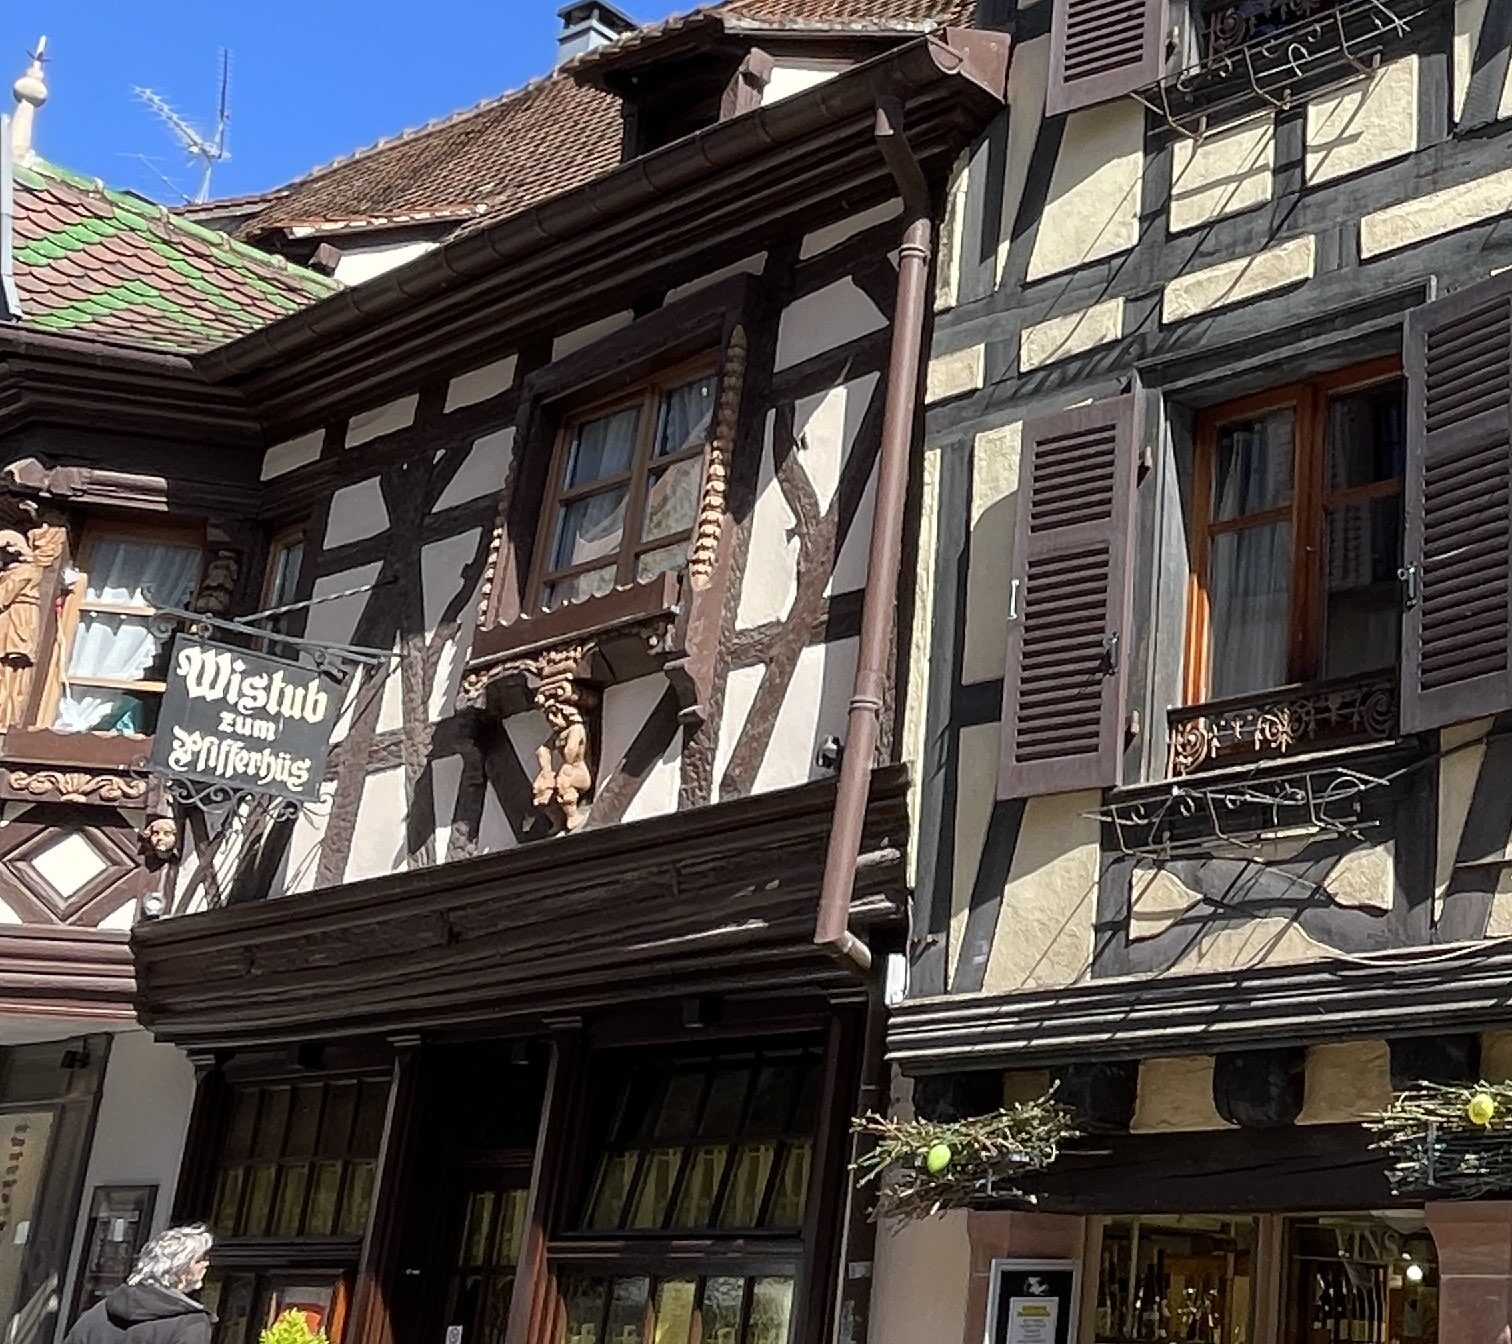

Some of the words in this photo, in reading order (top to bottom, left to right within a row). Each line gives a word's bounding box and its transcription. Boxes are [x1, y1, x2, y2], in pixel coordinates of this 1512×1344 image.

[177, 647, 328, 724] Wistub
[218, 711, 276, 741] zum
[168, 725, 312, 792] Pfifferhüs
[1334, 1223, 1400, 1262] VINS
